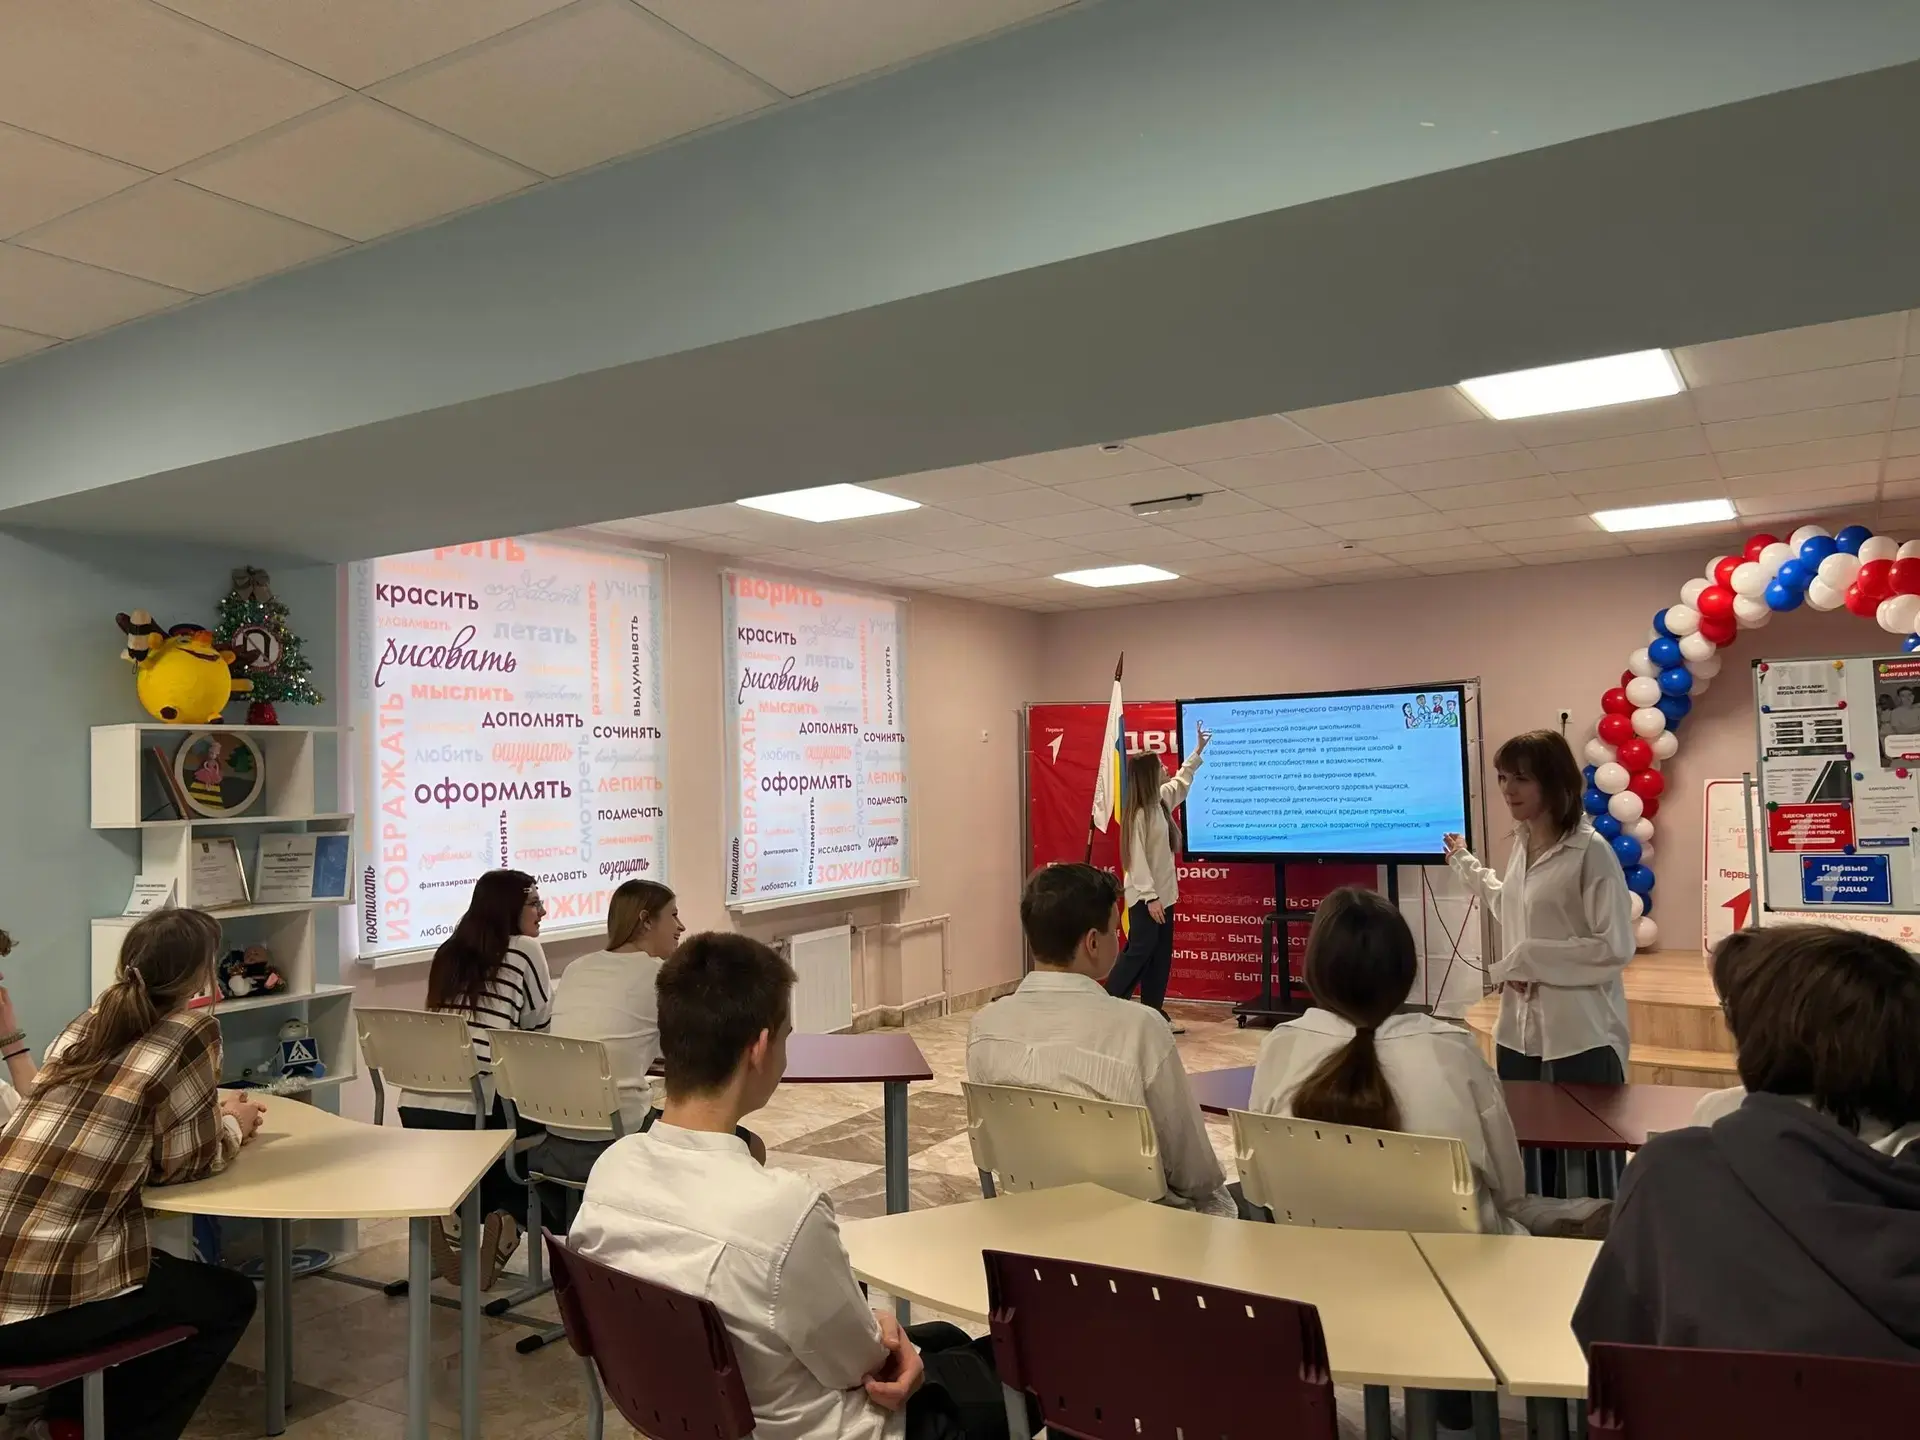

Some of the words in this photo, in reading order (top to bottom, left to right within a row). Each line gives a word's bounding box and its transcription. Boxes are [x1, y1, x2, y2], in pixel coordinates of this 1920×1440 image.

[375, 584, 479, 610] красить
[728, 573, 824, 609] творить
[493, 621, 578, 644] летать
[738, 627, 797, 646] красить
[374, 625, 517, 687] рисовать
[805, 653, 854, 671] летать
[630, 615, 642, 716] выдумывать
[738, 656, 819, 705] рисовать
[885, 646, 893, 725] выдумывать
[411, 683, 515, 702] мыслить
[759, 700, 819, 716] мыслить
[1231, 707, 1274, 717] Результаты
[1275, 705, 1326, 716] ученического
[1328, 702, 1395, 713] самоуправления
[481, 712, 584, 728] дополнять
[592, 726, 662, 739] сочинять
[799, 722, 859, 735] дополнять
[1247, 725, 1289, 734] гражданской
[1290, 724, 1318, 733] позиции
[863, 731, 905, 743] сочинять
[1247, 737, 1315, 745] заинтересованности
[1321, 735, 1353, 743] развитии
[414, 744, 484, 764] любить
[760, 747, 801, 762] любить
[1209, 748, 1253, 756] Возможность
[1297, 746, 1316, 754] детей
[1326, 745, 1366, 754] управлении
[1367, 744, 1394, 752] школой
[1267, 759, 1319, 767] способностями
[1325, 757, 1384, 765] возможностями.
[867, 770, 907, 785] лепить
[1248, 772, 1282, 780] занятости
[1283, 772, 1302, 780] детей
[1313, 772, 1352, 780] внеурочное
[1353, 771, 1377, 779] время.
[597, 775, 663, 793] лепить
[761, 771, 852, 796] оформлять
[1210, 784, 1245, 792] Улучшение
[1297, 783, 1340, 792] физического
[1341, 783, 1374, 791] здоровья
[414, 776, 572, 809] оформлять
[577, 734, 594, 864] смотреть
[1253, 796, 1291, 804] творческой
[1291, 796, 1338, 804] деятельности
[741, 708, 758, 895] ИЗОБРАЖАТЬ
[867, 795, 908, 806] подмечать
[379, 693, 411, 942] ИЗОБРАЖАТЬ
[597, 806, 664, 821] подмечать
[1211, 808, 1244, 816] Снижение
[1244, 808, 1282, 816] количества
[1304, 807, 1338, 816] имеющих
[1338, 808, 1369, 816] вредные
[1212, 821, 1246, 829] Снижение
[1245, 821, 1277, 830] динамики
[1278, 821, 1298, 830] роста
[1301, 820, 1328, 830] детской
[1329, 820, 1370, 830] возрастной
[818, 843, 862, 855] исследовать
[599, 856, 650, 886] созерцать
[730, 836, 740, 896] постигать
[816, 857, 900, 884] зажигать
[1821, 864, 1869, 873] Первые
[760, 880, 797, 892] любоваться
[1824, 886, 1868, 894] сердца
[366, 864, 378, 943] постигать
[419, 923, 458, 938] любов
[1227, 933, 1263, 944] БЫТЬ
[1171, 950, 1199, 961] ЫТЬ
[1199, 951, 1209, 961] В
